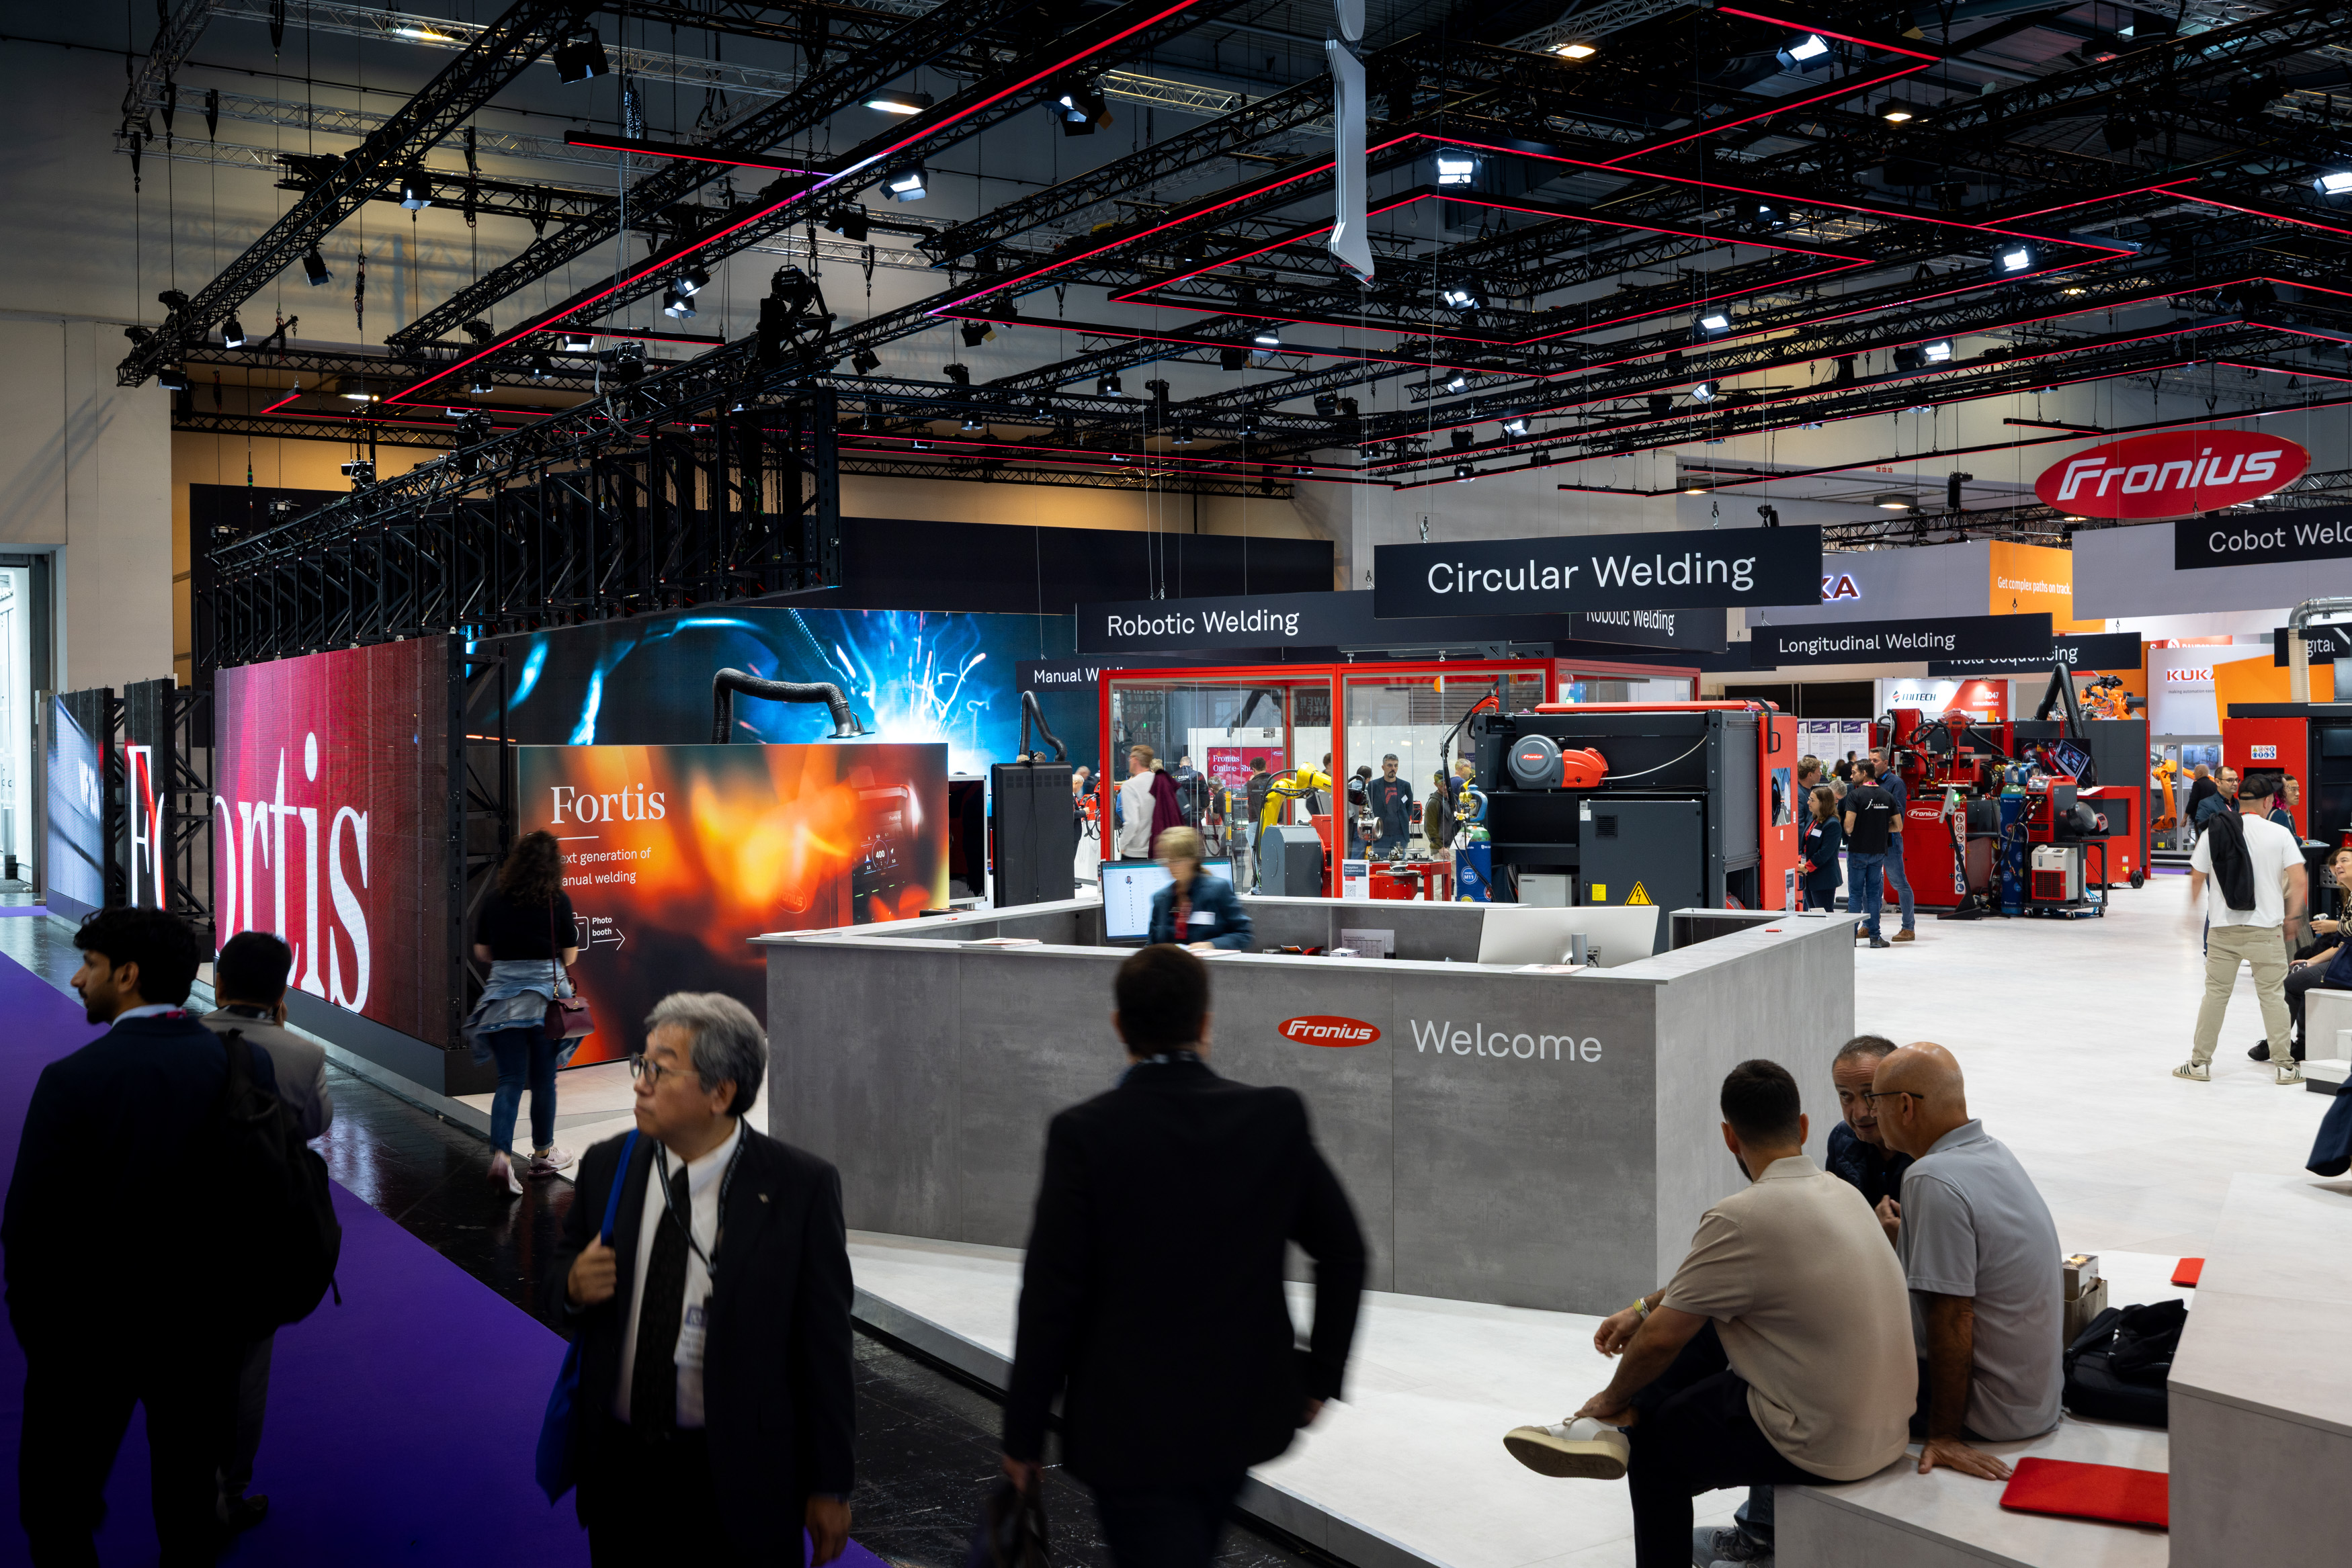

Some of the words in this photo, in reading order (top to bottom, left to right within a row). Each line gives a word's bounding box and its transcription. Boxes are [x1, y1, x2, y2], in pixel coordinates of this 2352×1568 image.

[2057, 447, 2283, 501] Fronius
[2208, 527, 2286, 553] Cobot
[1427, 559, 1579, 594] Circular
[1591, 552, 1756, 591] Welding
[1998, 576, 2008, 589] Get
[2009, 578, 2032, 593] complex
[2033, 580, 2048, 594] paths
[2048, 584, 2056, 593] on
[2056, 582, 2072, 595] track.
[1107, 613, 1195, 636] Robotic
[1202, 609, 1300, 636] Welding
[1633, 610, 1675, 636] Welding
[1779, 635, 1880, 656] Longitudinal
[1886, 632, 1956, 651] Welding
[1034, 668, 1082, 684] Manual
[1902, 693, 1936, 701] MITECH
[1213, 754, 1240, 763] Fronius
[550, 783, 666, 824] Fortis
[560, 853, 577, 864] ext
[580, 849, 638, 866] generation
[640, 847, 652, 859] of
[876, 850, 885, 859] 400
[562, 873, 592, 887] anual
[595, 871, 636, 884] welding
[592, 916, 612, 925] Photo
[592, 927, 612, 937] booth
[1286, 1020, 1373, 1041] Fronius
[1410, 1019, 1603, 1063] Welcome
